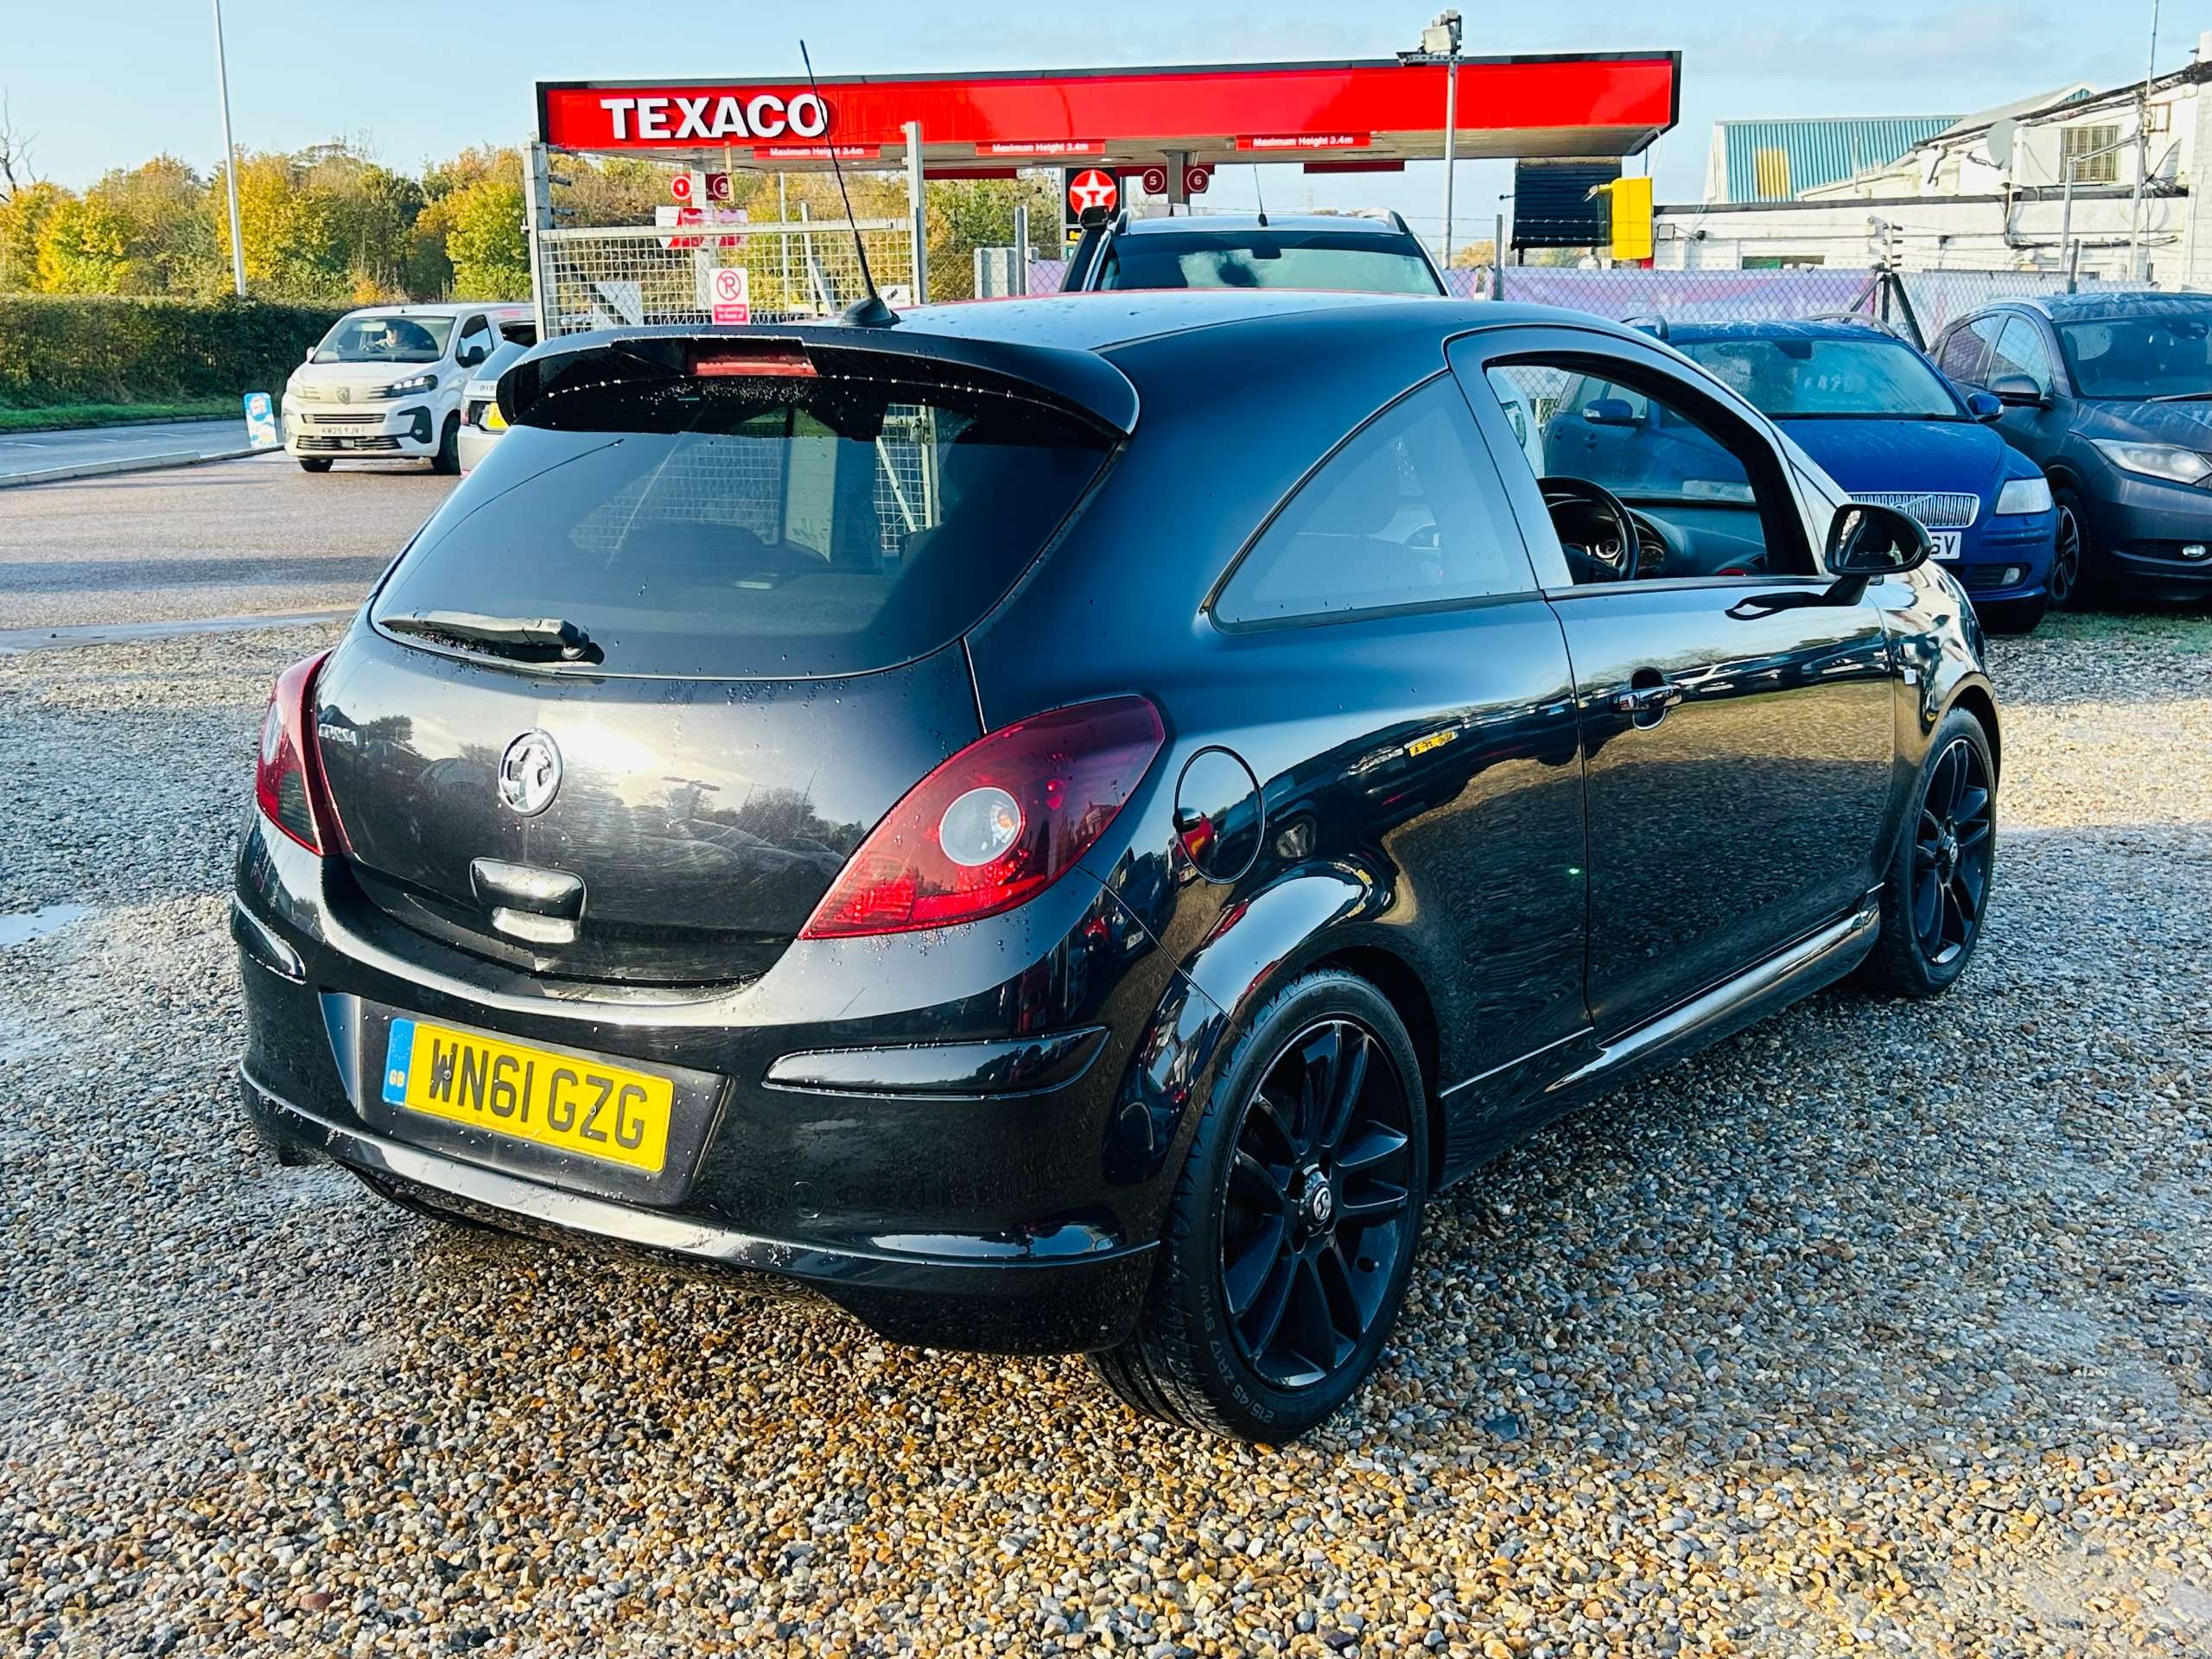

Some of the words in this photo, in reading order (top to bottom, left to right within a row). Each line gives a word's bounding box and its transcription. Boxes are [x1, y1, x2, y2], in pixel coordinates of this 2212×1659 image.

[600, 93, 828, 139] TEXACO
[1298, 137, 1328, 147] Height
[1330, 136, 1353, 145] 3.4m
[1036, 143, 1065, 153] Height
[1066, 143, 1089, 151] 3.4m
[1149, 175, 1156, 185] 5
[1193, 175, 1201, 185] 6
[720, 182, 728, 193] 2
[429, 1039, 534, 1122] WN61
[547, 1068, 647, 1149] GZG
